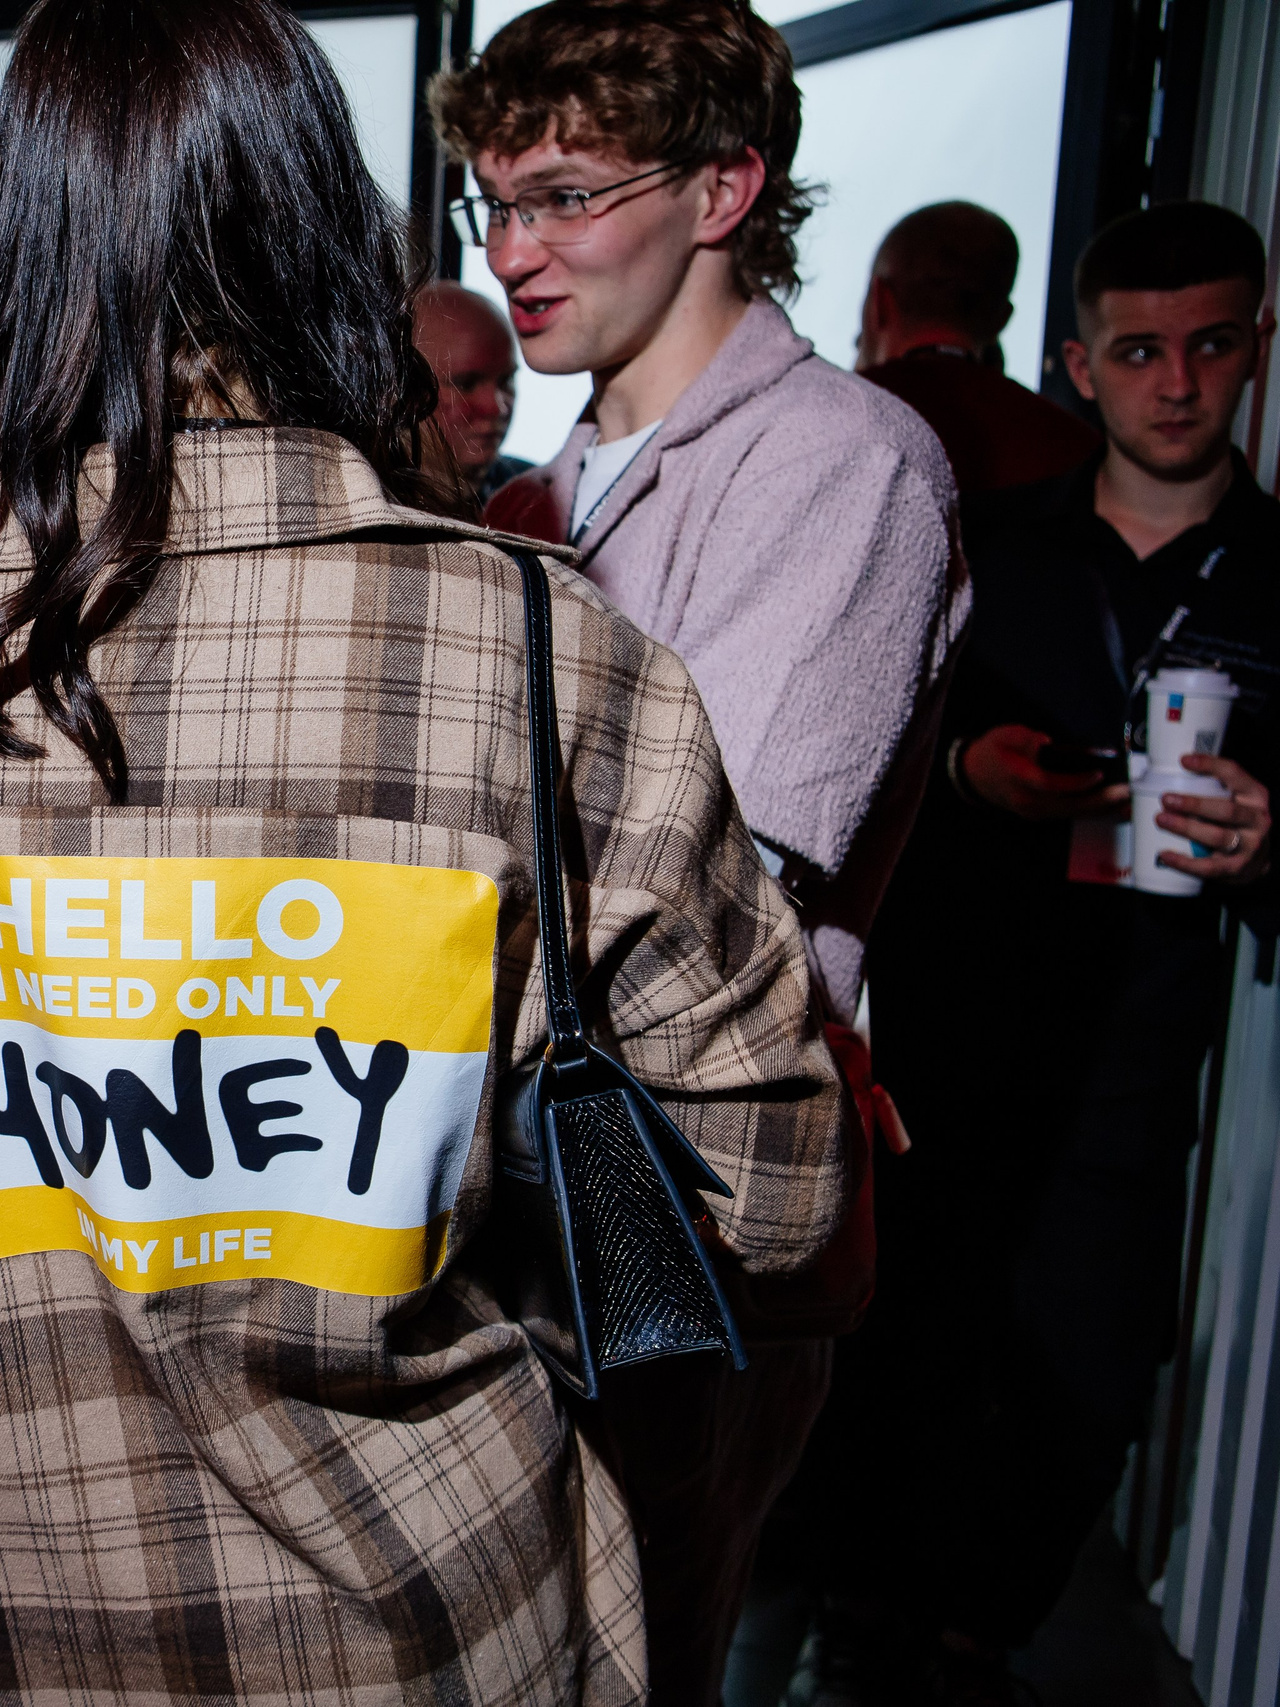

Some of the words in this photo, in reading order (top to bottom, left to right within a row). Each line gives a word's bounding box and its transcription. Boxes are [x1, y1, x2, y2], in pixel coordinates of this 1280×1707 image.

[16, 969, 157, 1019] NEED
[176, 974, 342, 1018] ONLY
[76, 1207, 98, 1252] IN
[99, 1231, 159, 1274] MY
[173, 1228, 272, 1269] LIFE
